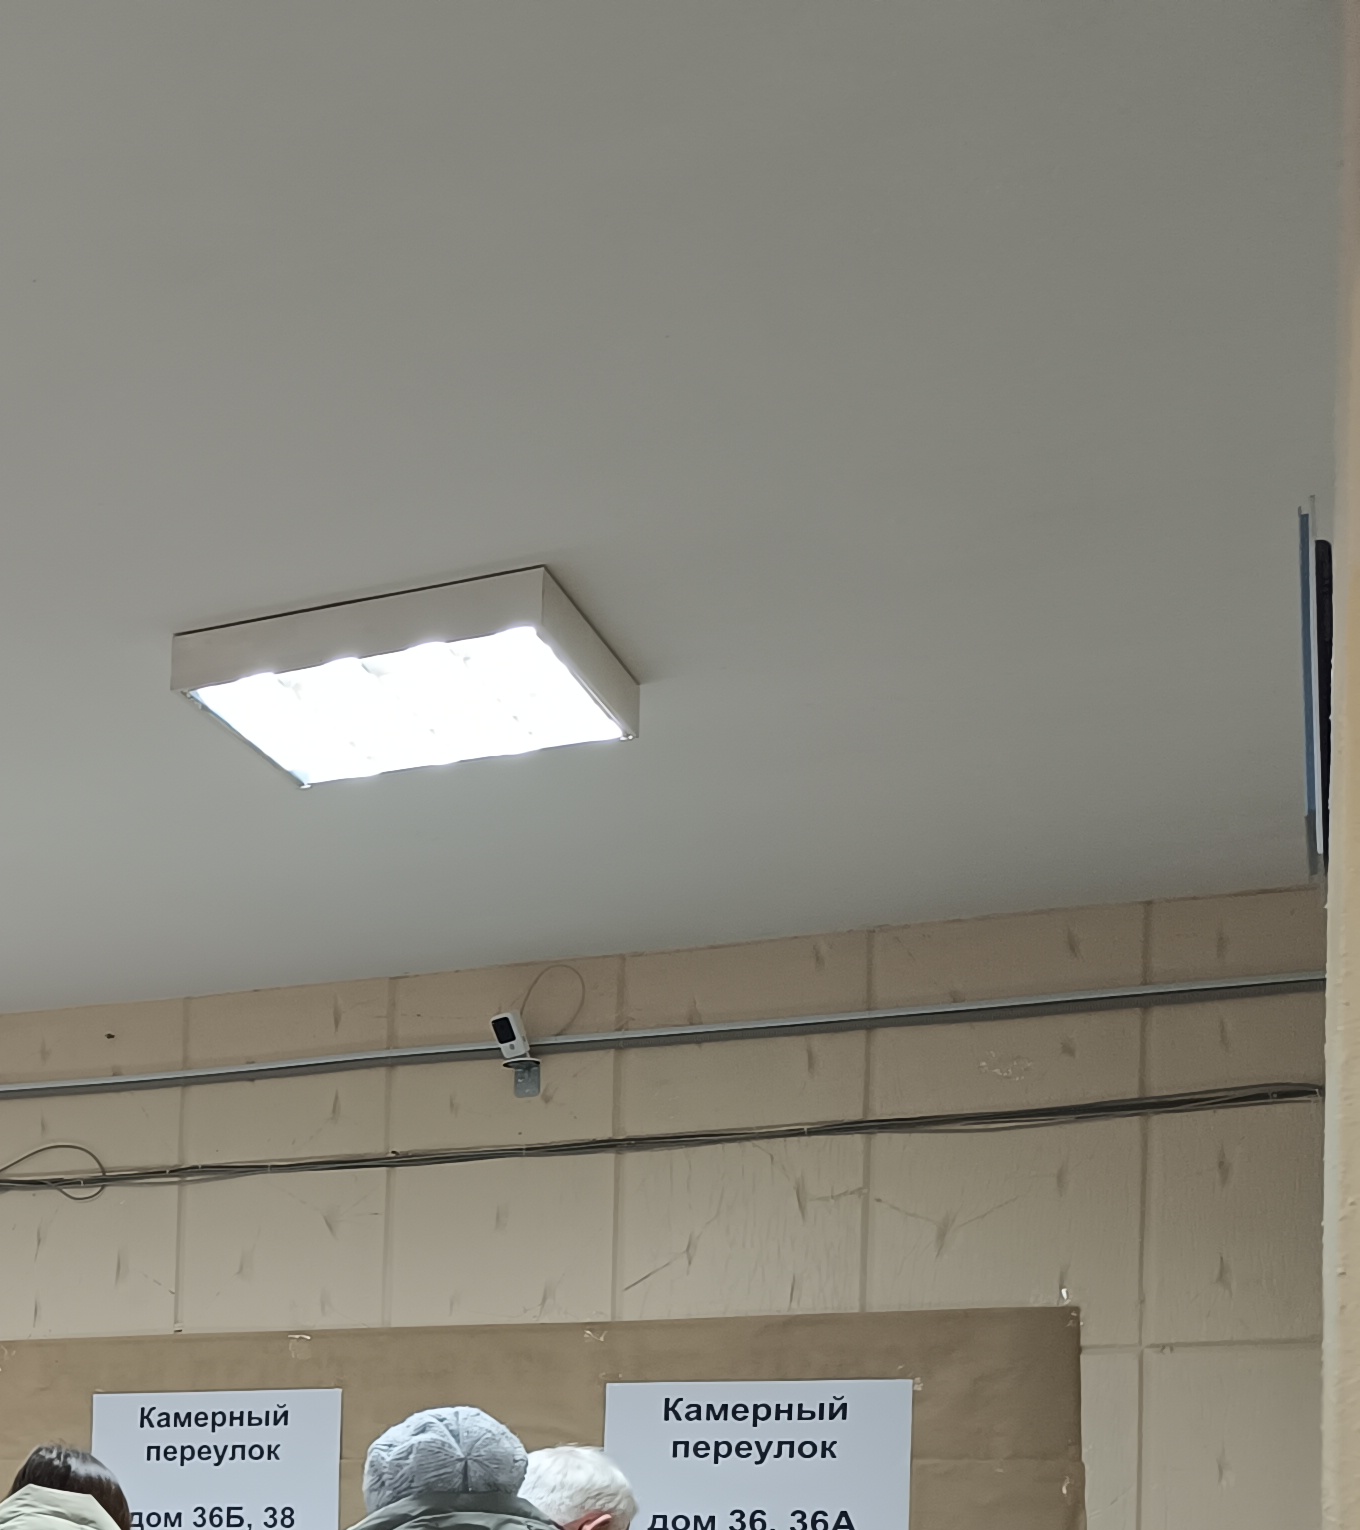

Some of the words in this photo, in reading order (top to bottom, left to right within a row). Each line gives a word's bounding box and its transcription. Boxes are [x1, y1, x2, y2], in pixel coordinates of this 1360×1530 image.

[139, 1403, 289, 1432] Камерный
[663, 1395, 848, 1427] Камерный
[146, 1444, 281, 1466] переулок
[671, 1440, 837, 1464] переулок
[130, 1511, 182, 1530] дом
[263, 1506, 295, 1529] 38
